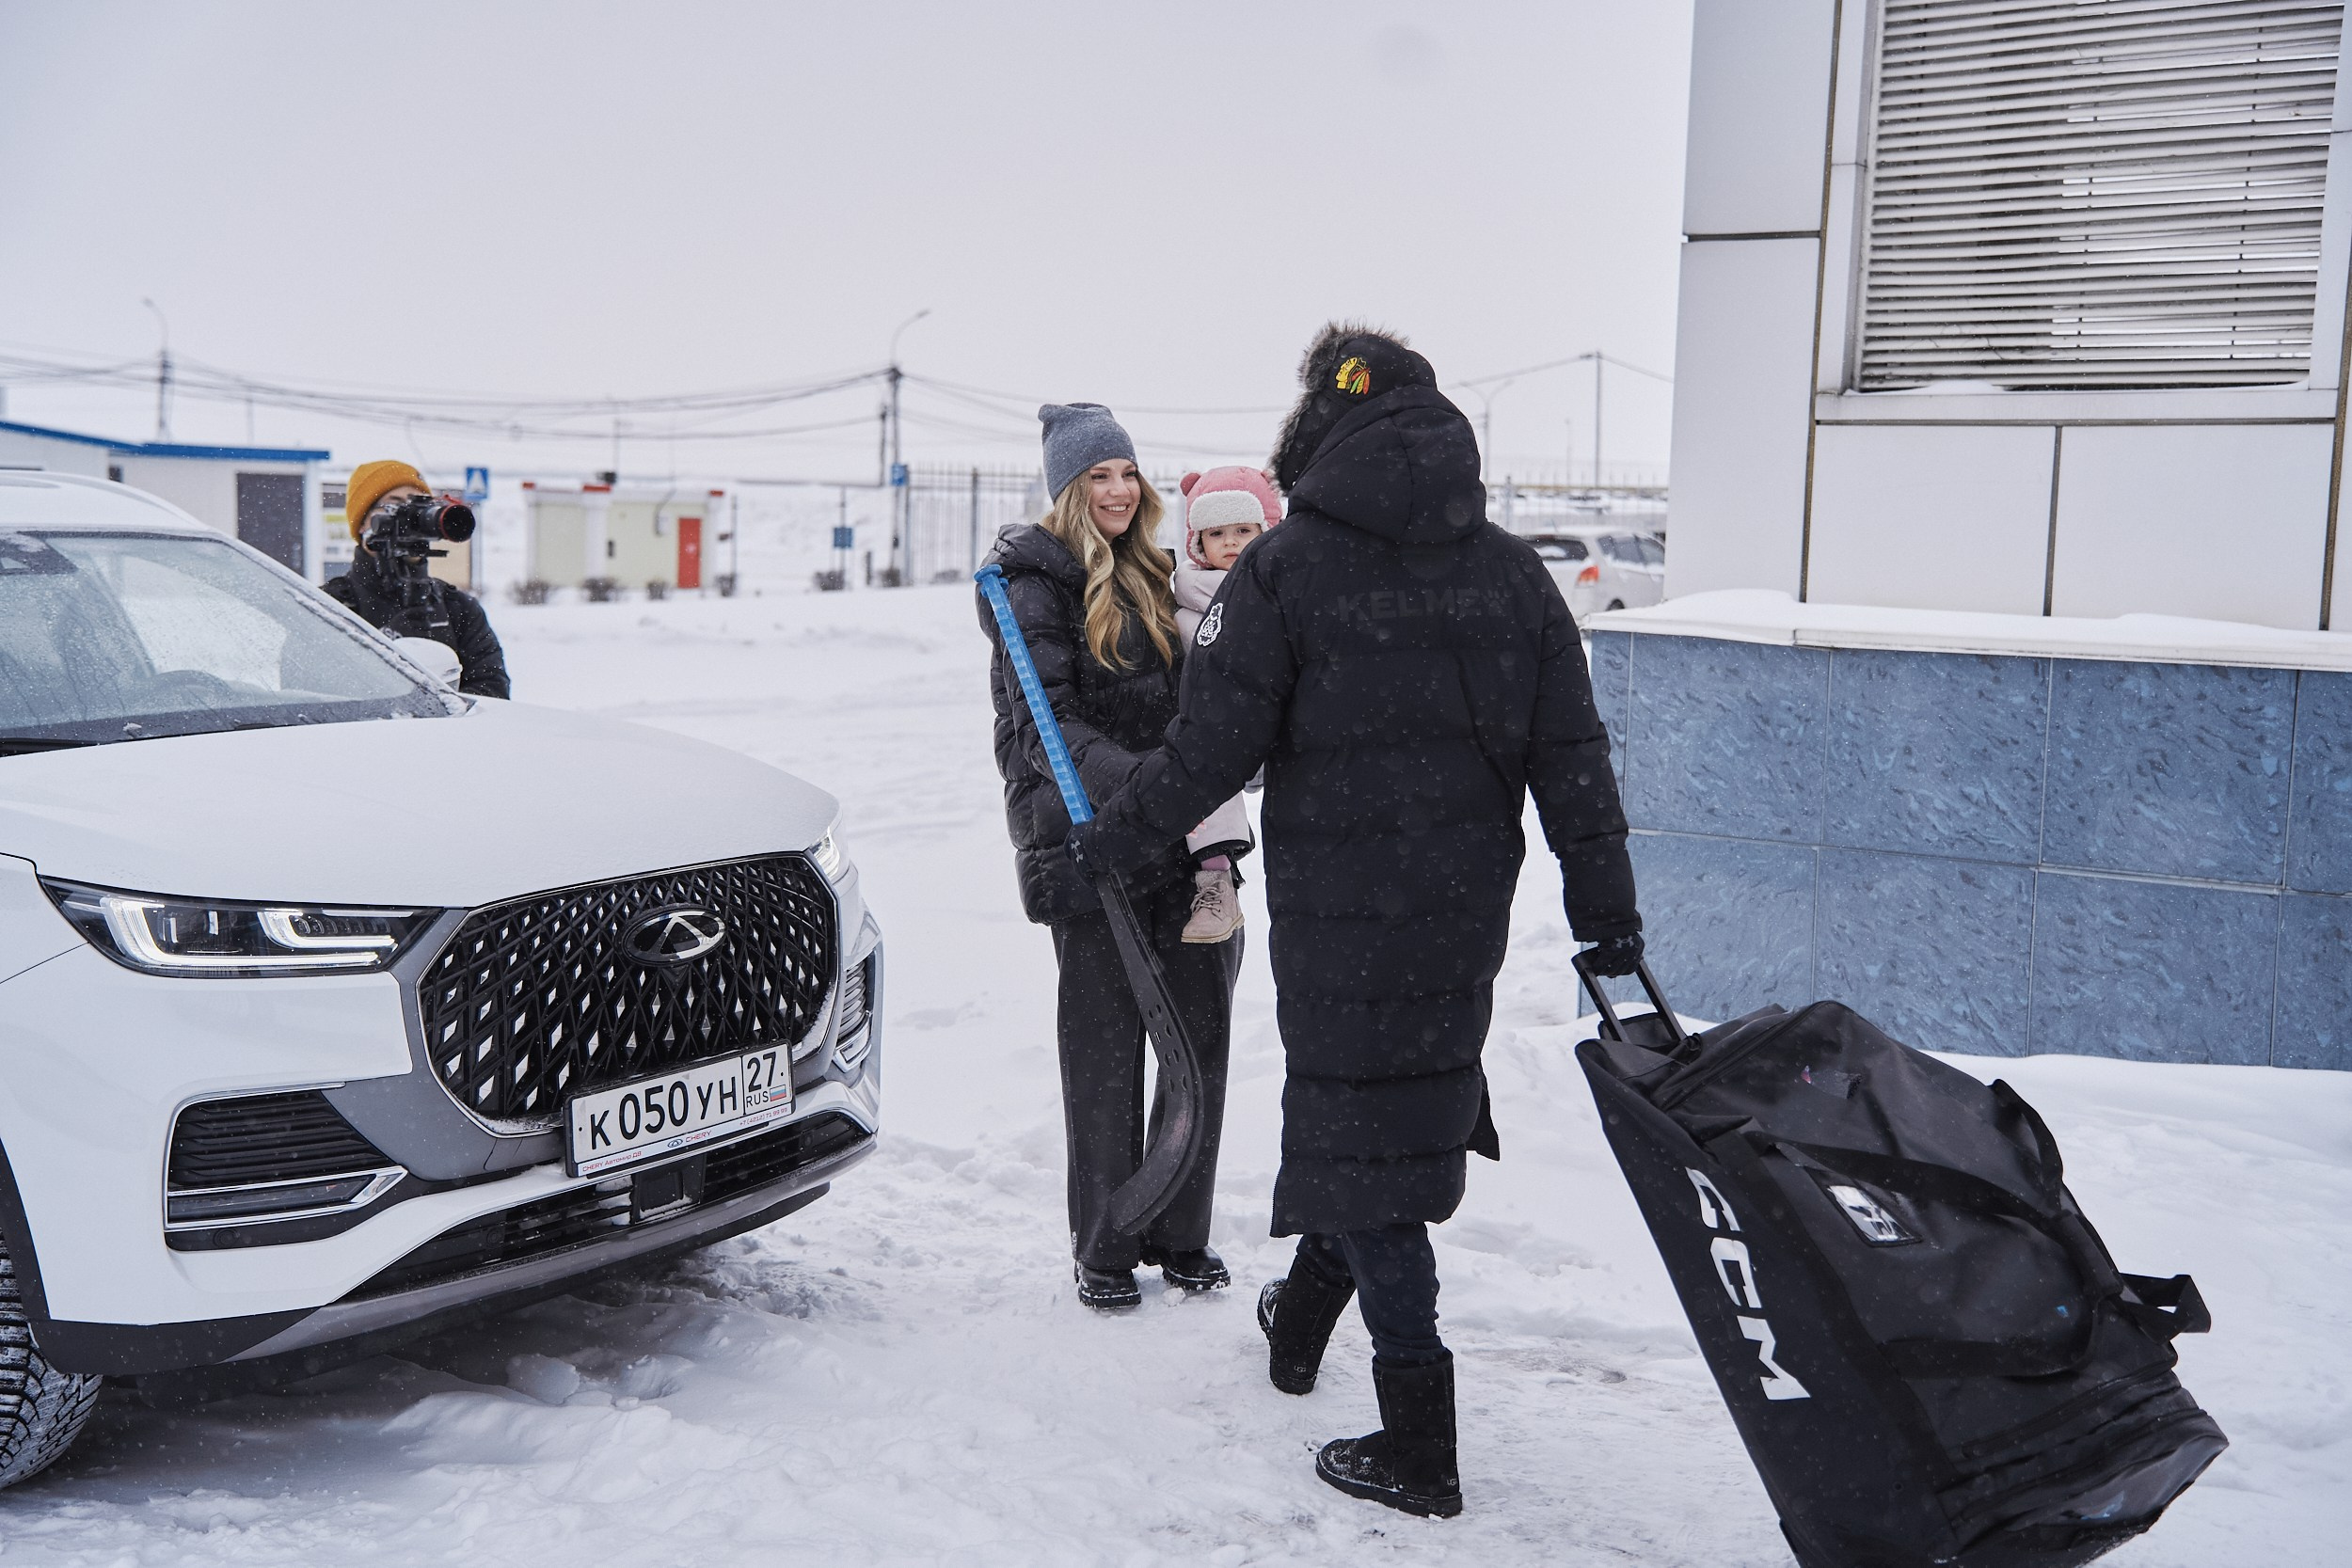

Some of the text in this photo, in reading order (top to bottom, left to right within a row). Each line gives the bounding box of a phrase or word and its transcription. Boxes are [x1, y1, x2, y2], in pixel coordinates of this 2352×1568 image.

[1337, 588, 1482, 622] KELME
[746, 1052, 777, 1094] 27
[745, 1090, 770, 1108] RUS
[685, 1130, 712, 1143] CHERY
[582, 1162, 604, 1172] CHERY
[1685, 1166, 1811, 1401] CCM
